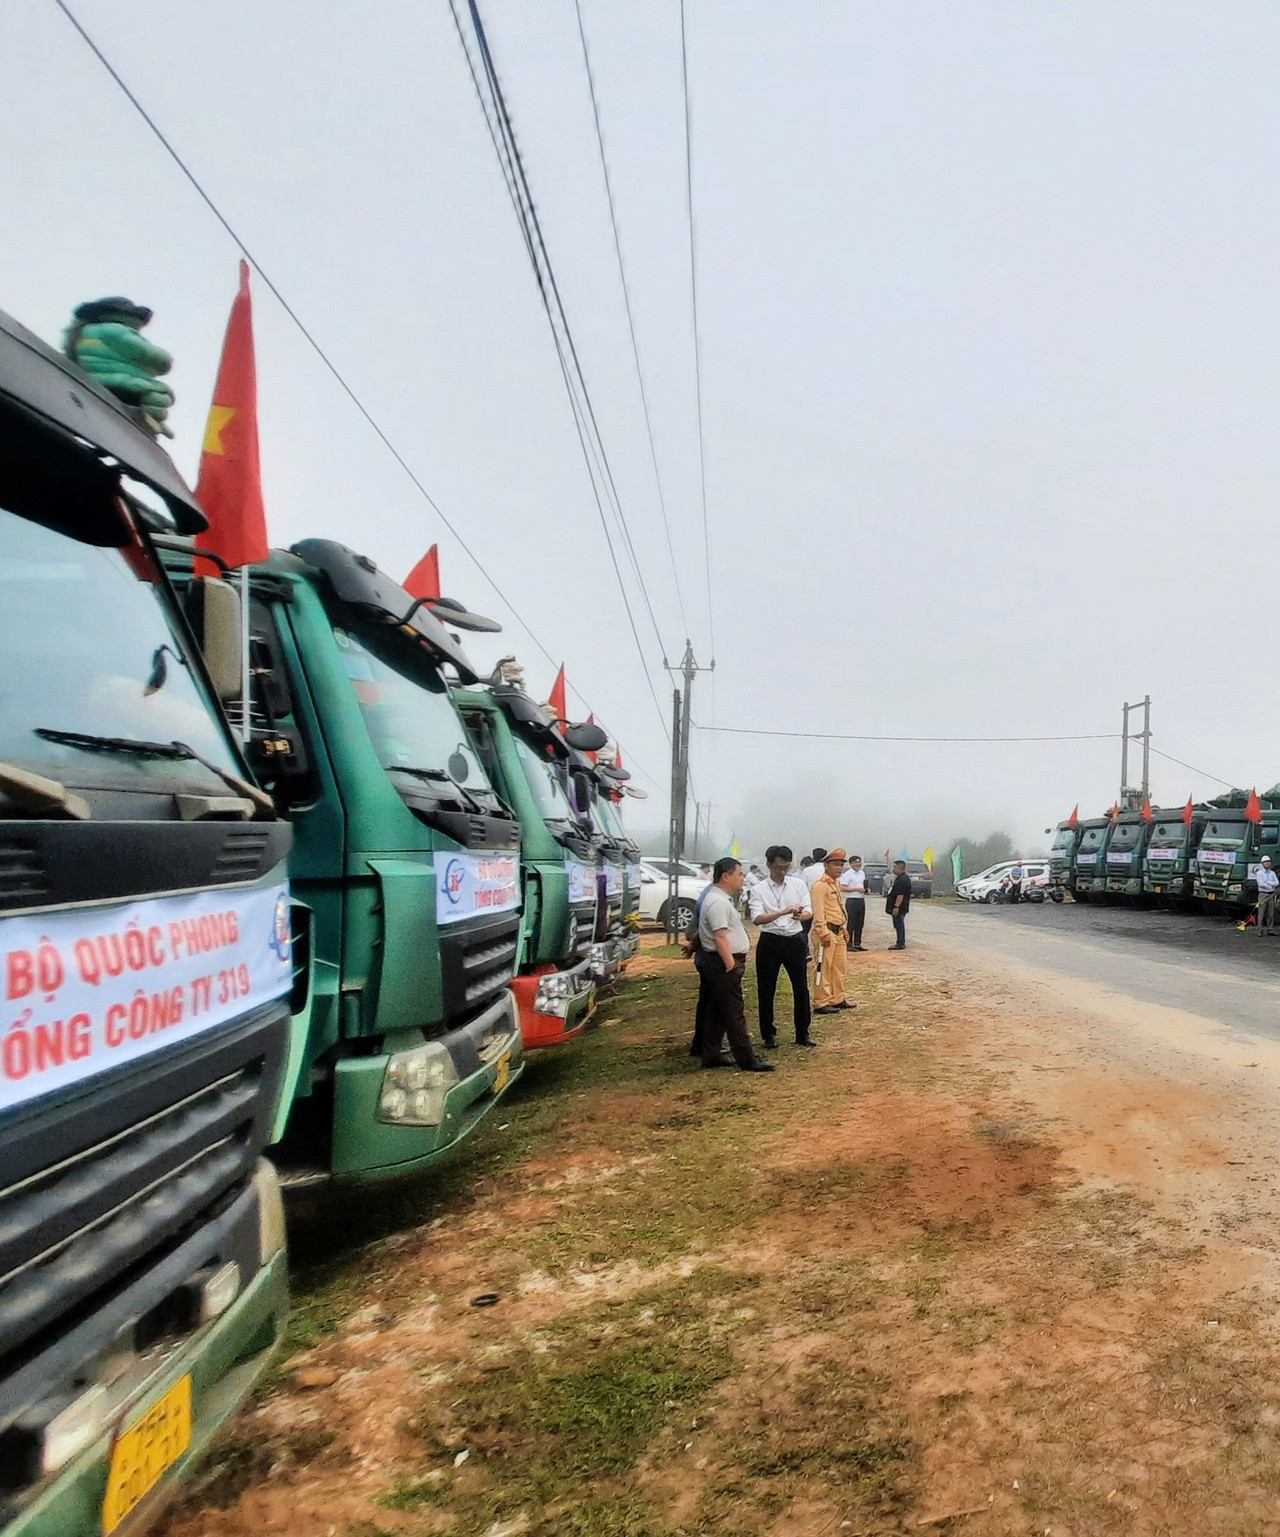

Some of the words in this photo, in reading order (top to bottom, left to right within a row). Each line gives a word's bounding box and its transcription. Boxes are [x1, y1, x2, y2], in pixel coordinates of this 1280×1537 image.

[6, 935, 65, 1003] BỘ
[73, 914, 165, 986] QUỐC
[0, 1008, 92, 1081] ỔNG
[104, 988, 185, 1047] CÔNG
[190, 975, 214, 1016] TY
[218, 963, 251, 1005] 319
